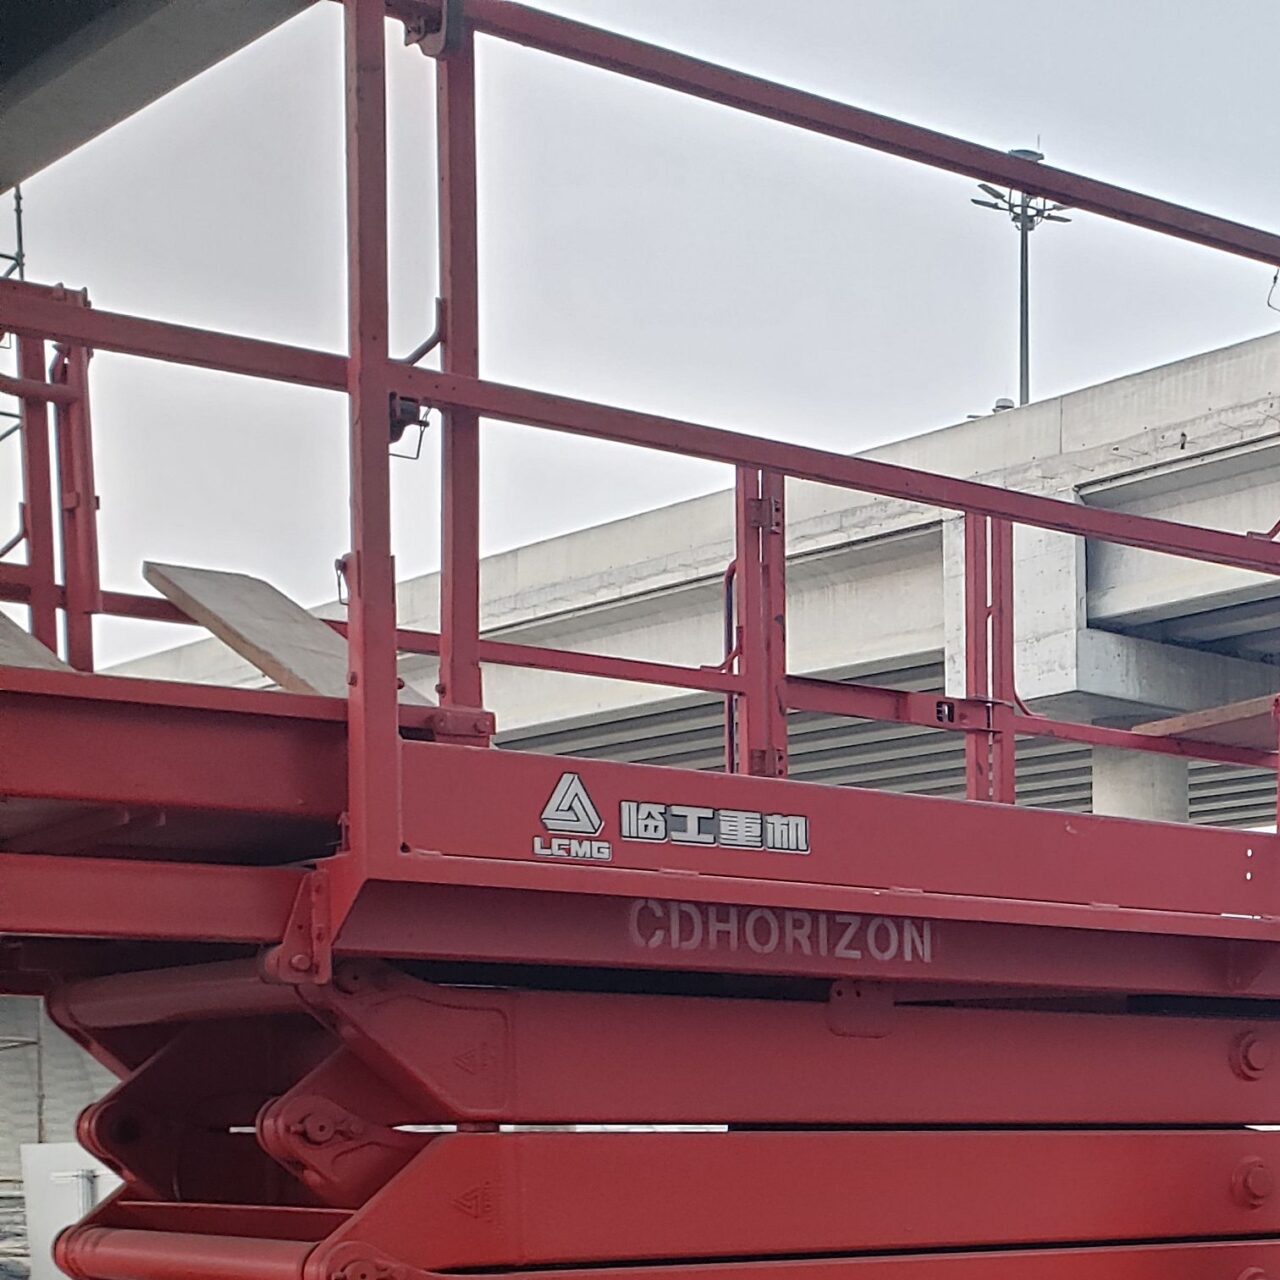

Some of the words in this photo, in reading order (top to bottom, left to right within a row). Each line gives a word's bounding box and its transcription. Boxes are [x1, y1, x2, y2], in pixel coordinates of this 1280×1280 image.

[620, 801, 809, 853] 临工重机
[628, 899, 933, 964] CDHORIZON
